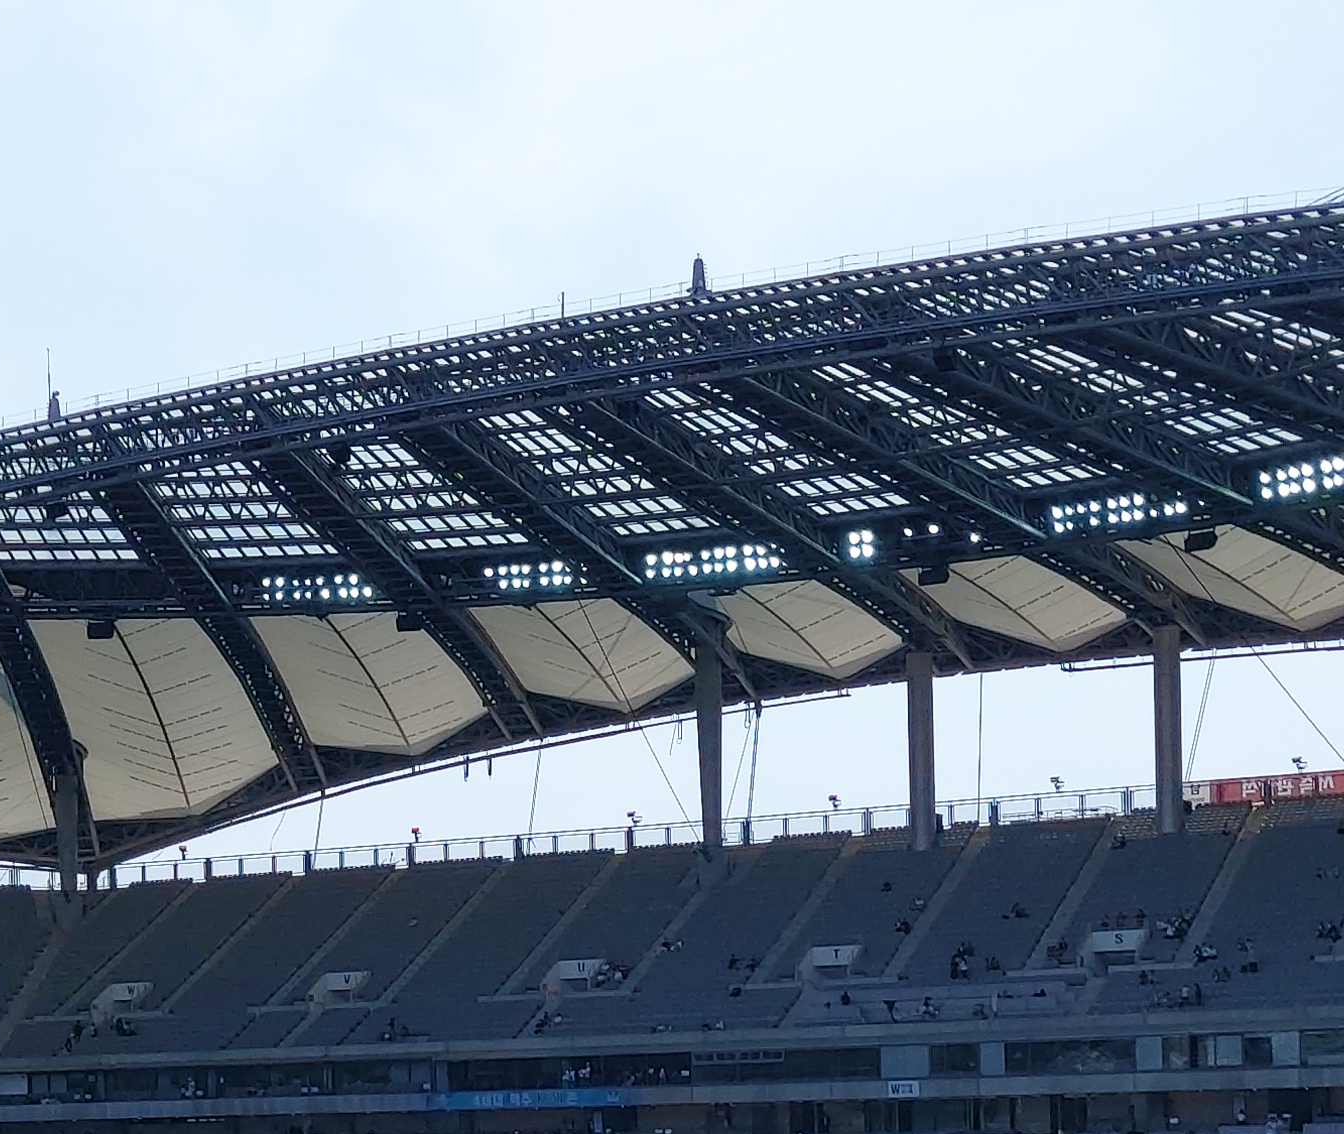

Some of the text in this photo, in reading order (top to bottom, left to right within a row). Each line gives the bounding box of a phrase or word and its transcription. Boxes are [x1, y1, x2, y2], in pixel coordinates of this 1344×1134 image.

[1115, 933, 1123, 944] S
[833, 949, 840, 959] T
[577, 962, 585, 972] U
[344, 975, 351, 984] V
